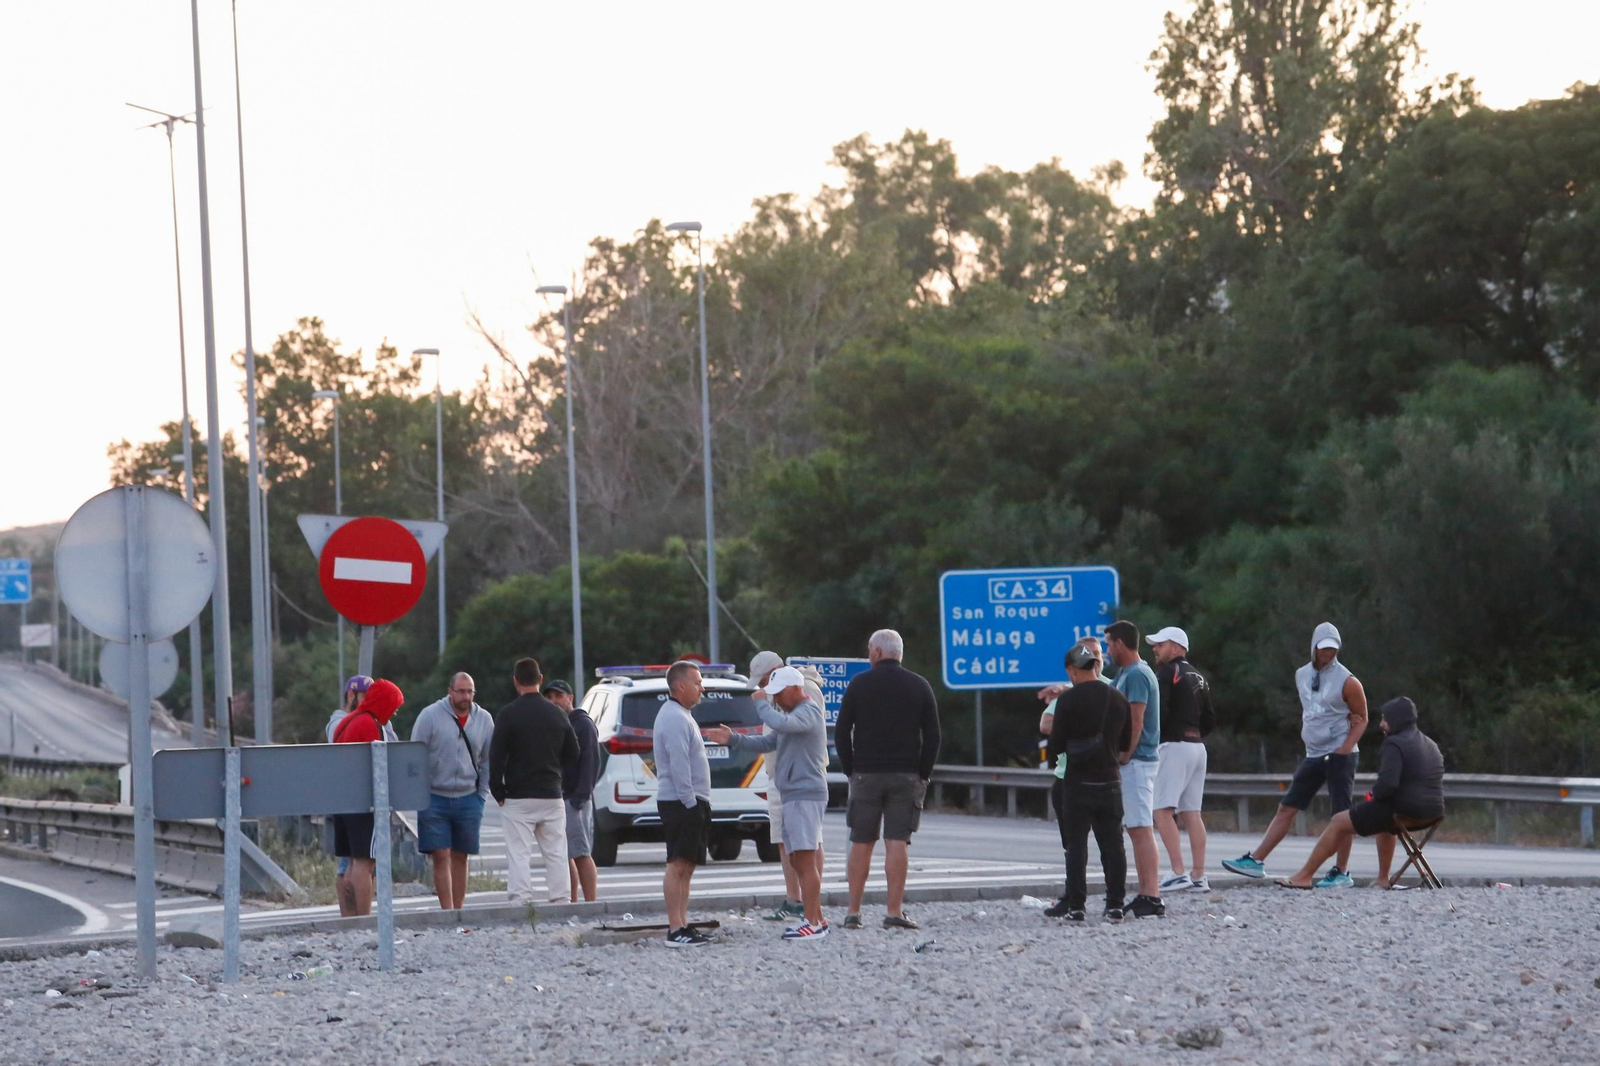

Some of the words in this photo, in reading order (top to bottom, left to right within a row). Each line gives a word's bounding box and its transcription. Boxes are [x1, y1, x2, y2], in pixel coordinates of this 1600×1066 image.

[993, 580, 1067, 598] CA-34
[952, 606, 984, 620] San
[995, 605, 1049, 620] Roque
[1098, 601, 1108, 615] 3
[952, 628, 1035, 650] Málaga
[953, 657, 1020, 675] Cádiz
[821, 678, 850, 689] Roqu
[824, 691, 844, 704] diz
